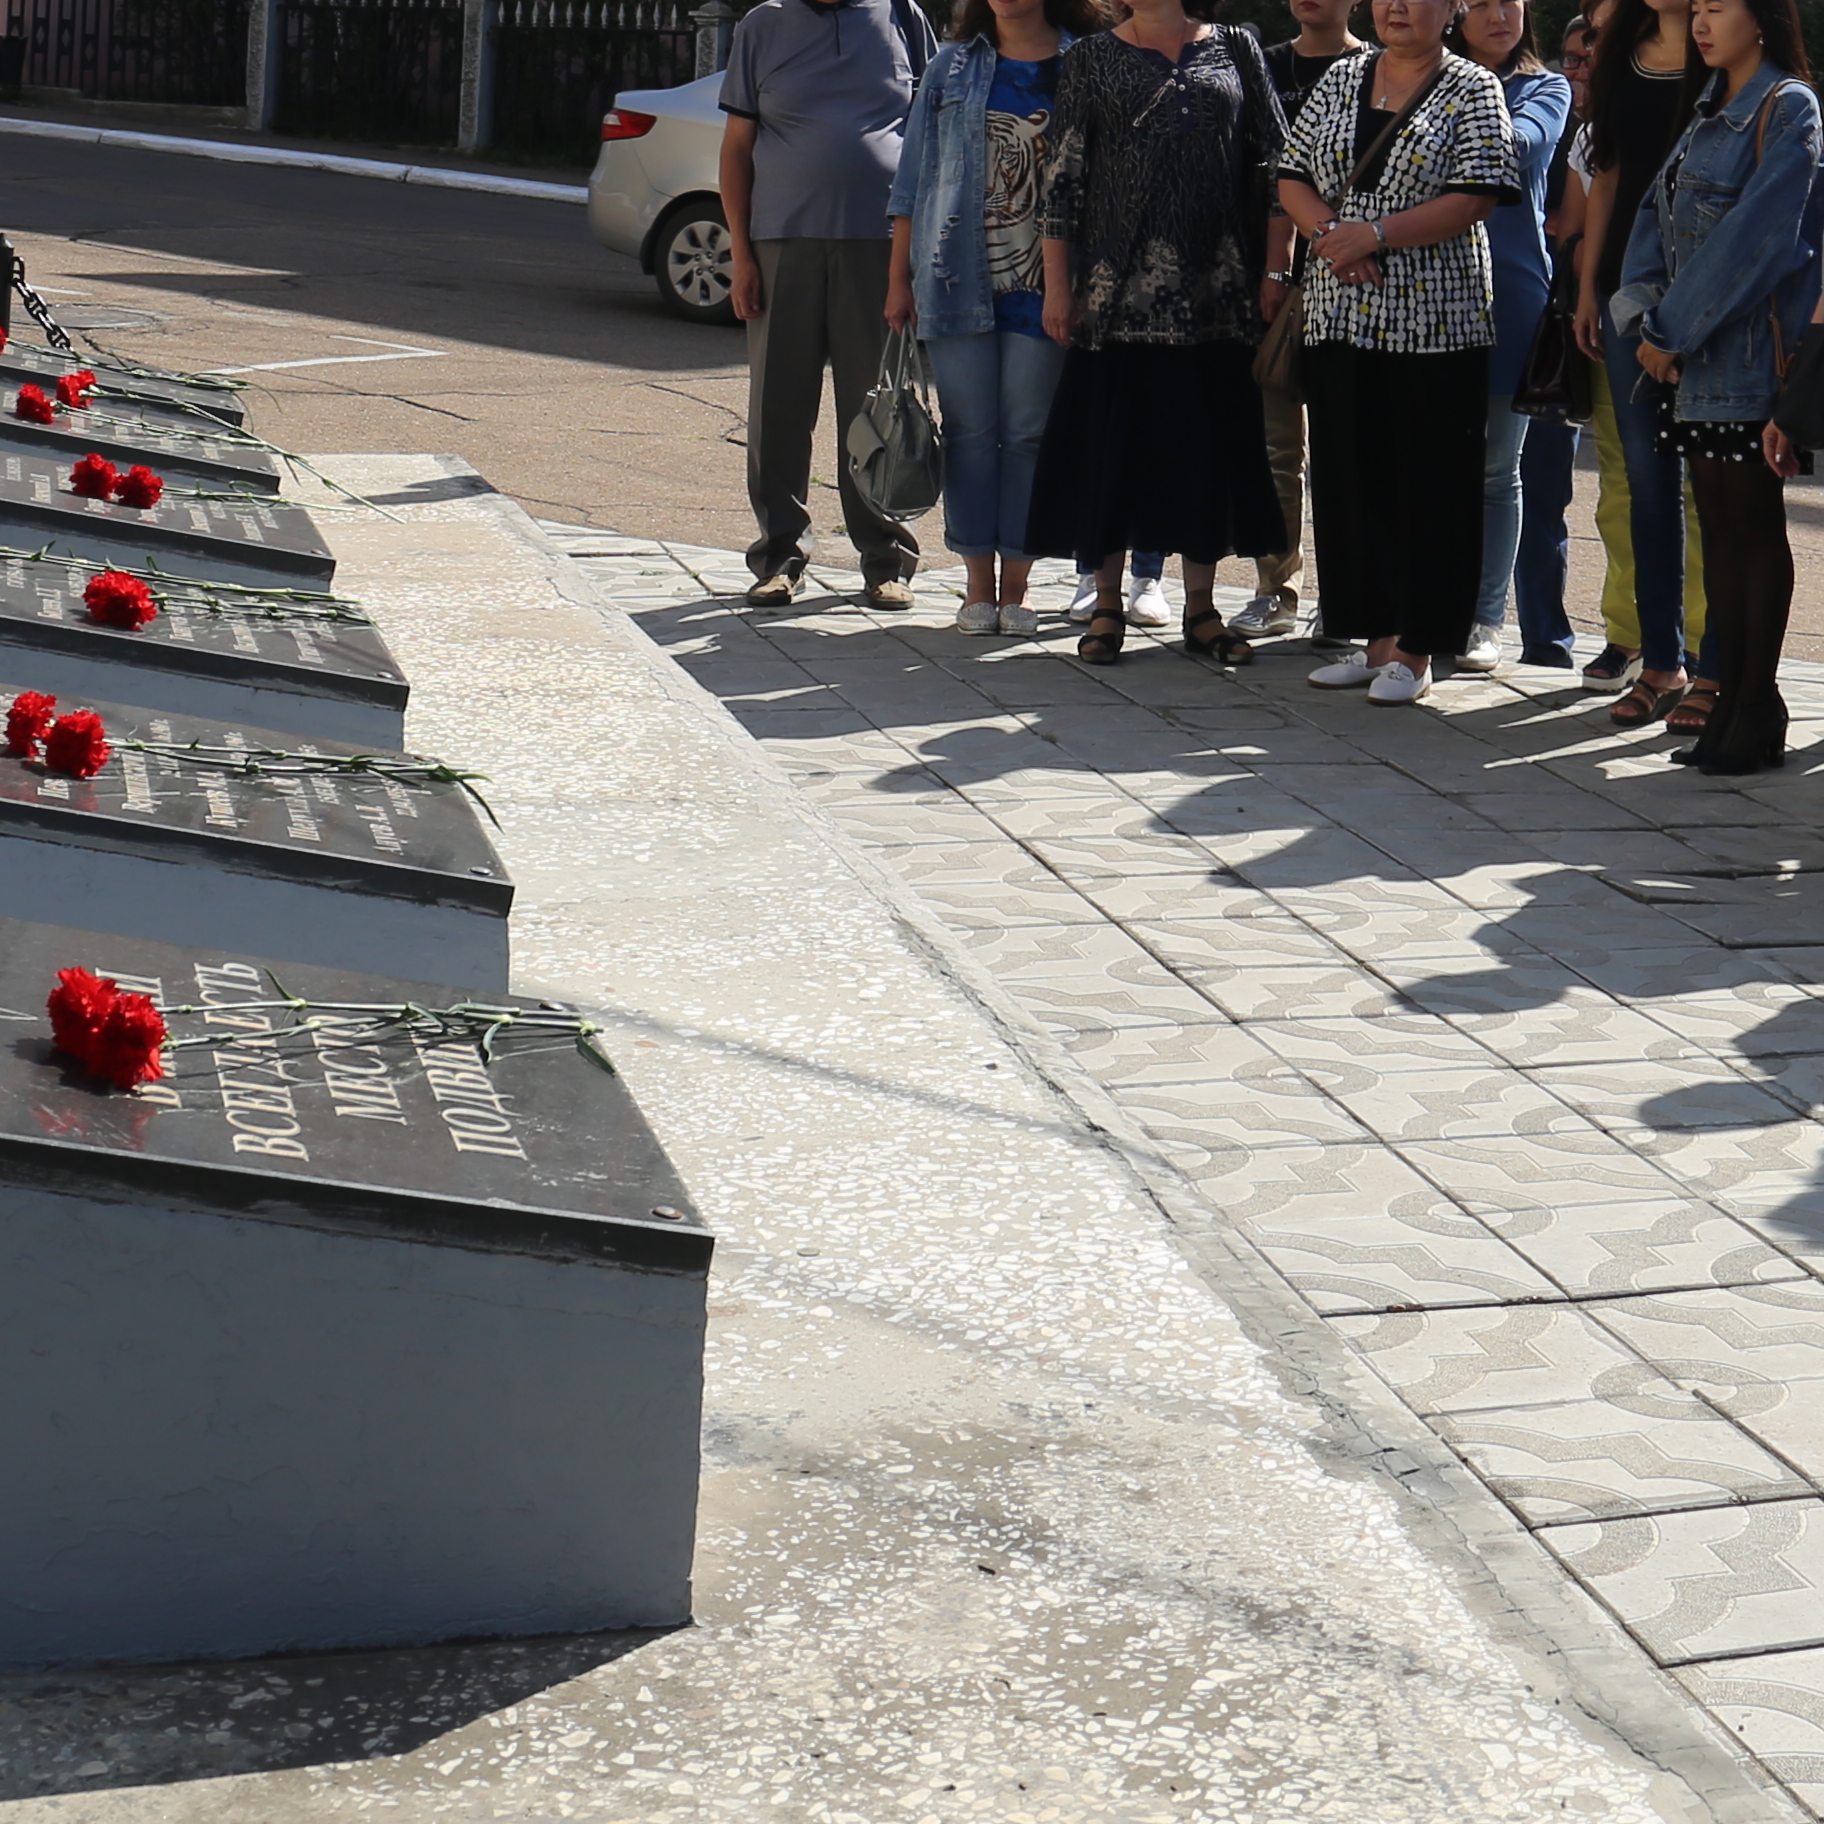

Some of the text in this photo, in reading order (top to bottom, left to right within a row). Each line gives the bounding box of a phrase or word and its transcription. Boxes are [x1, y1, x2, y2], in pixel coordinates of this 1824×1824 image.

[194, 961, 310, 1162] ВСЕГДА ЕСТЬ
[307, 1014, 408, 1126] МЕСТО
